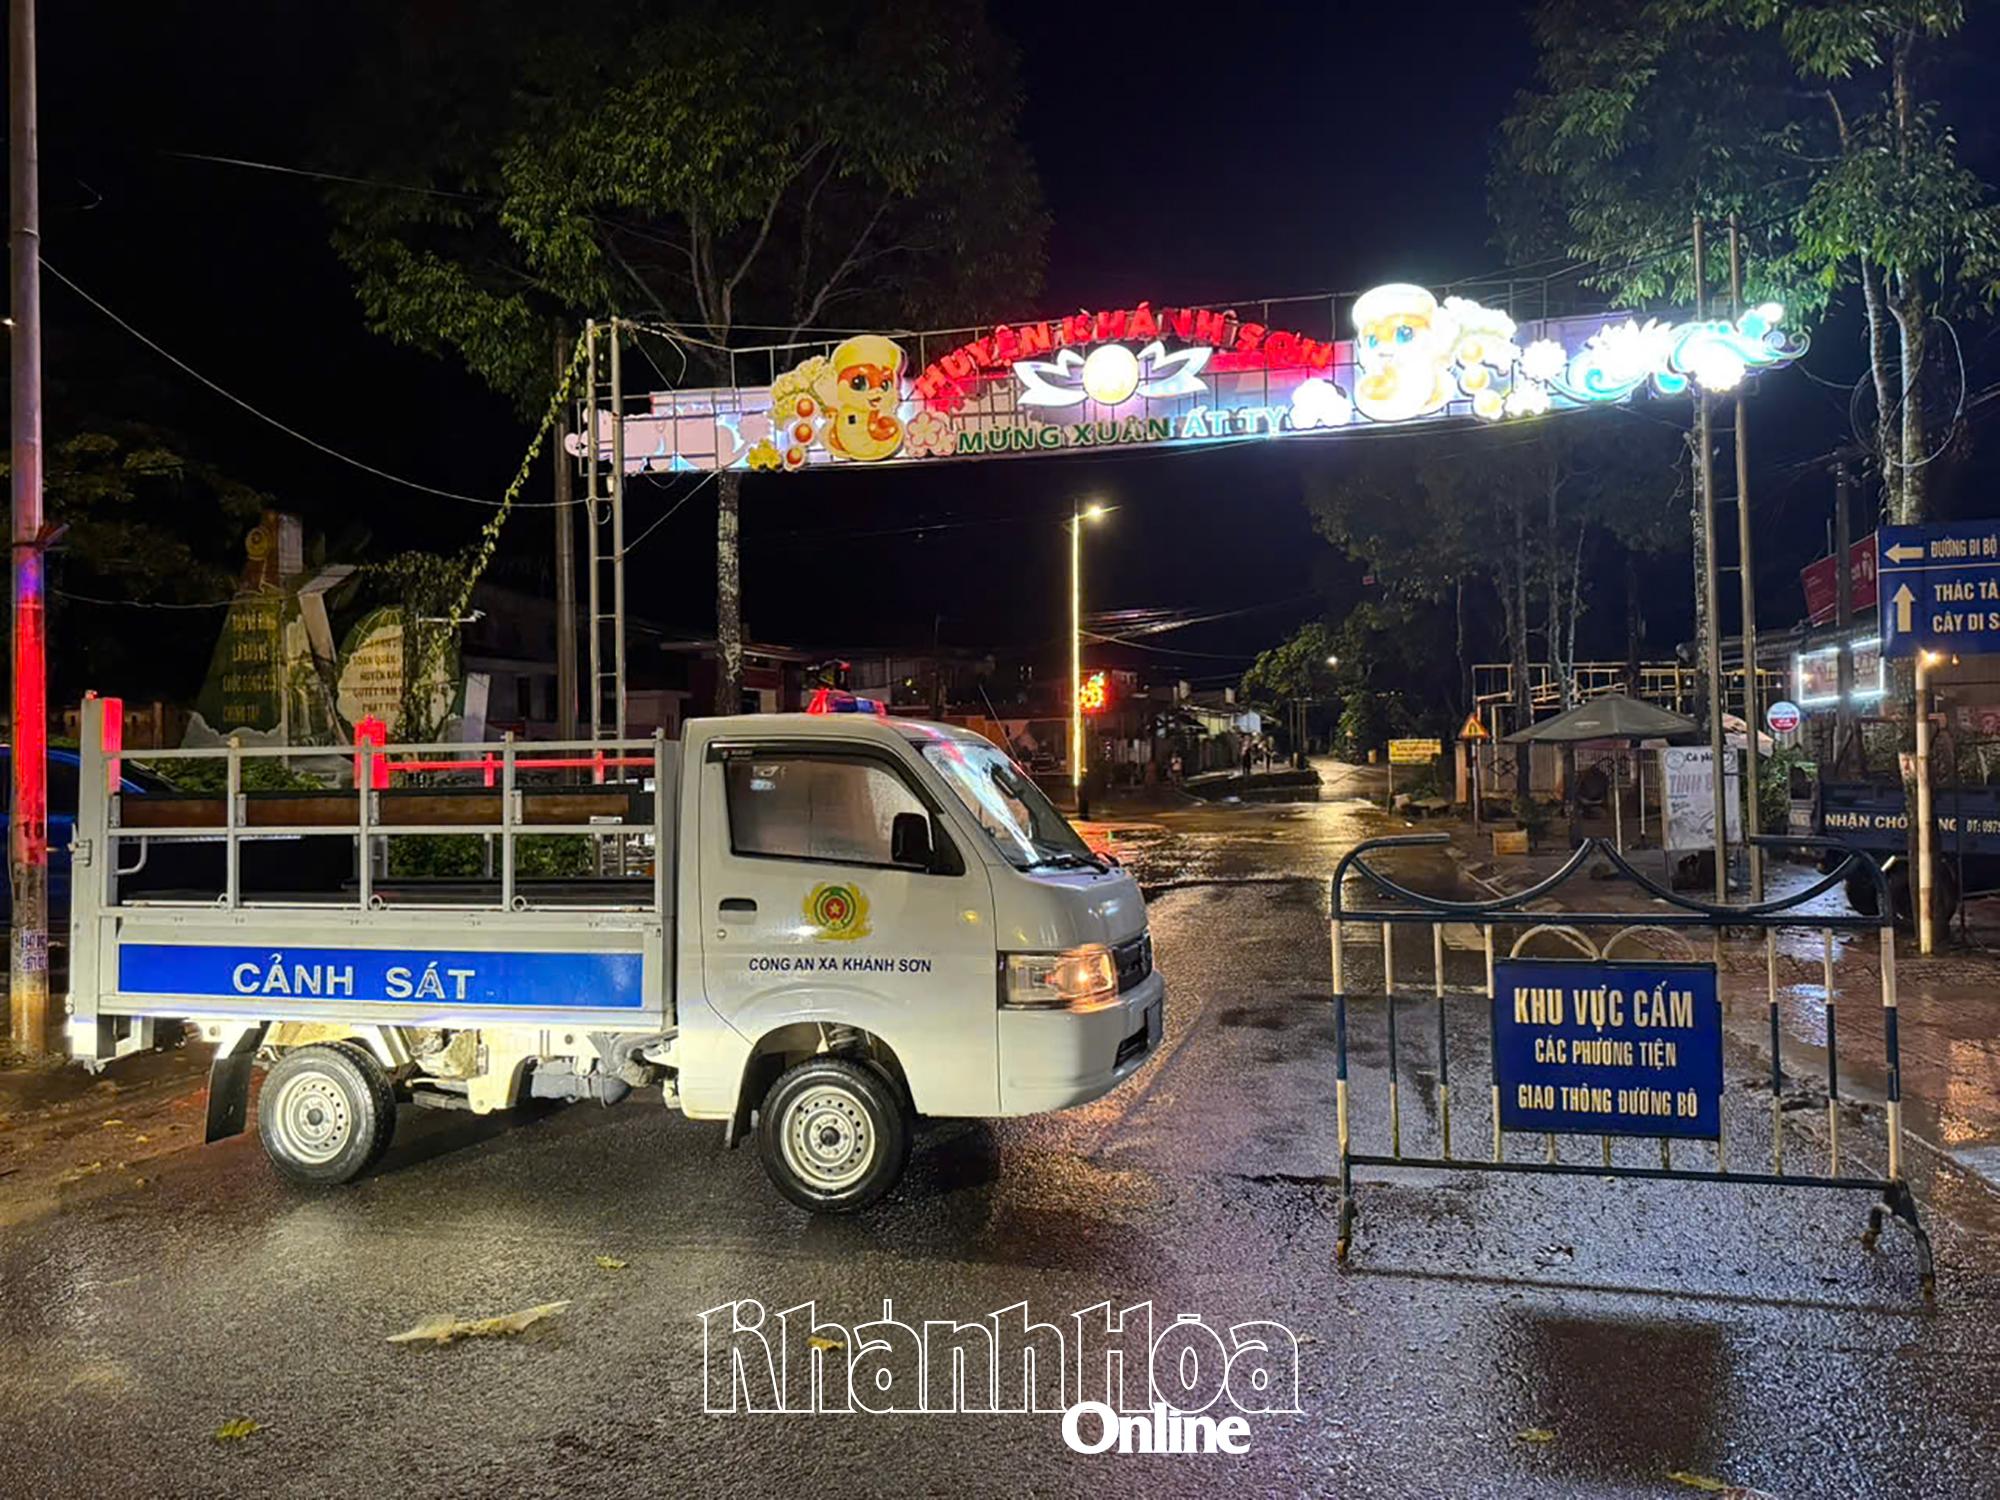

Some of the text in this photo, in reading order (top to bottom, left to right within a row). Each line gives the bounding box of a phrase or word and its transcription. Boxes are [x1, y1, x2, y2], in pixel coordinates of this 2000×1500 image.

[916, 324, 1052, 399] HUYỆN
[1062, 301, 1226, 347] KHÁNH
[957, 426, 1061, 454] MỪNG
[1072, 415, 1171, 445] XUÂN
[1181, 406, 1231, 438] ẤT
[1932, 610, 1964, 633] CÂY
[1968, 613, 1984, 631] DI
[232, 953, 476, 1000] CẢNH SÁT
[794, 957, 815, 971] AN
[843, 954, 895, 972] KHÁNH
[898, 958, 931, 973] SƠN
[1513, 980, 1694, 1032] KHU VỰC CẤM
[1535, 1034, 1677, 1071] CÁC PHƯƠNG TIỆN
[1518, 1084, 1554, 1110] GIAO
[1560, 1082, 1612, 1113] THÔNG
